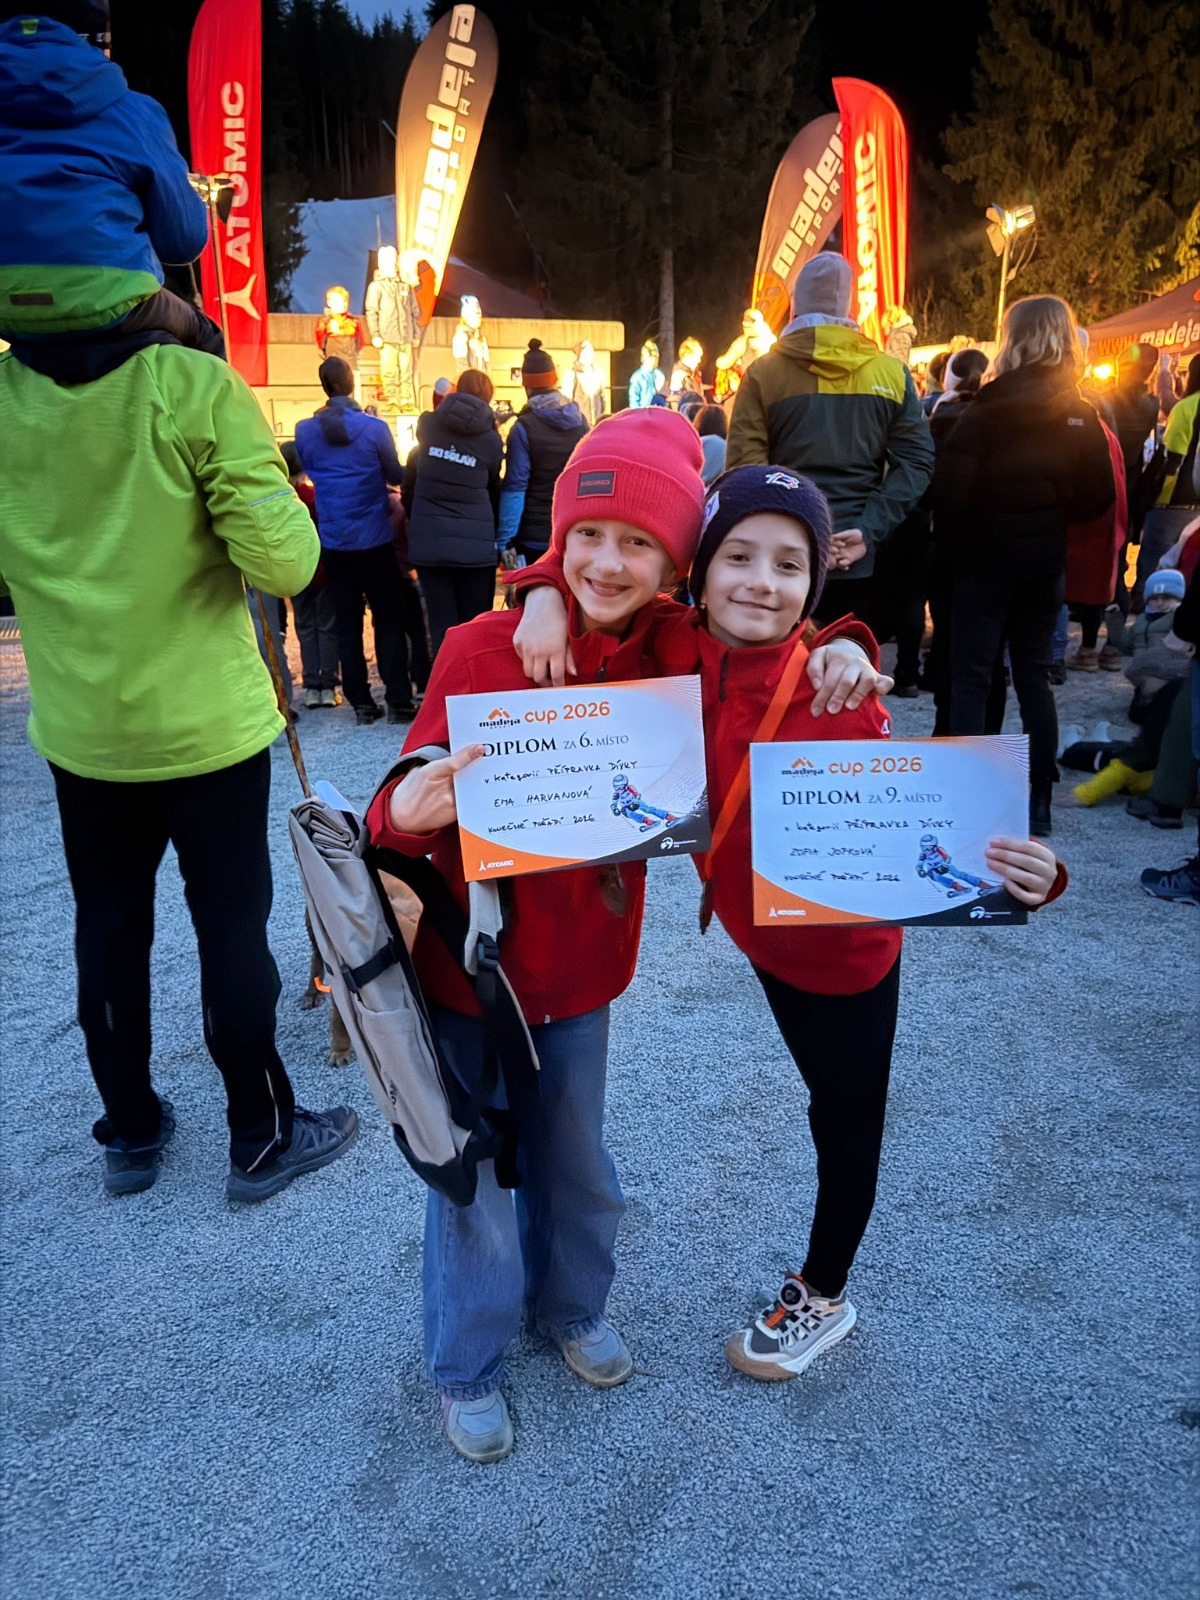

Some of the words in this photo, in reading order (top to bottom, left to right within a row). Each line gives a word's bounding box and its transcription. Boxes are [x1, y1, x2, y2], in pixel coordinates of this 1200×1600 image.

[221, 81, 251, 268] ATOMIC
[772, 121, 843, 280] madej
[524, 709, 557, 725] cup
[563, 701, 610, 719] 2026
[482, 737, 557, 757] DIPLOM
[563, 740, 577, 750] ZA
[579, 731, 593, 748] 6.
[596, 734, 629, 747] MÍSTO
[828, 761, 864, 777] cup
[870, 756, 922, 773] 2026
[494, 798, 515, 808] EMA
[526, 785, 592, 804] HARVANOVÁ
[781, 789, 862, 805] DIPLOM
[868, 794, 883, 804] ZA
[885, 786, 901, 804] 9.
[904, 792, 943, 803] MÍSTO
[573, 813, 595, 825] 2026
